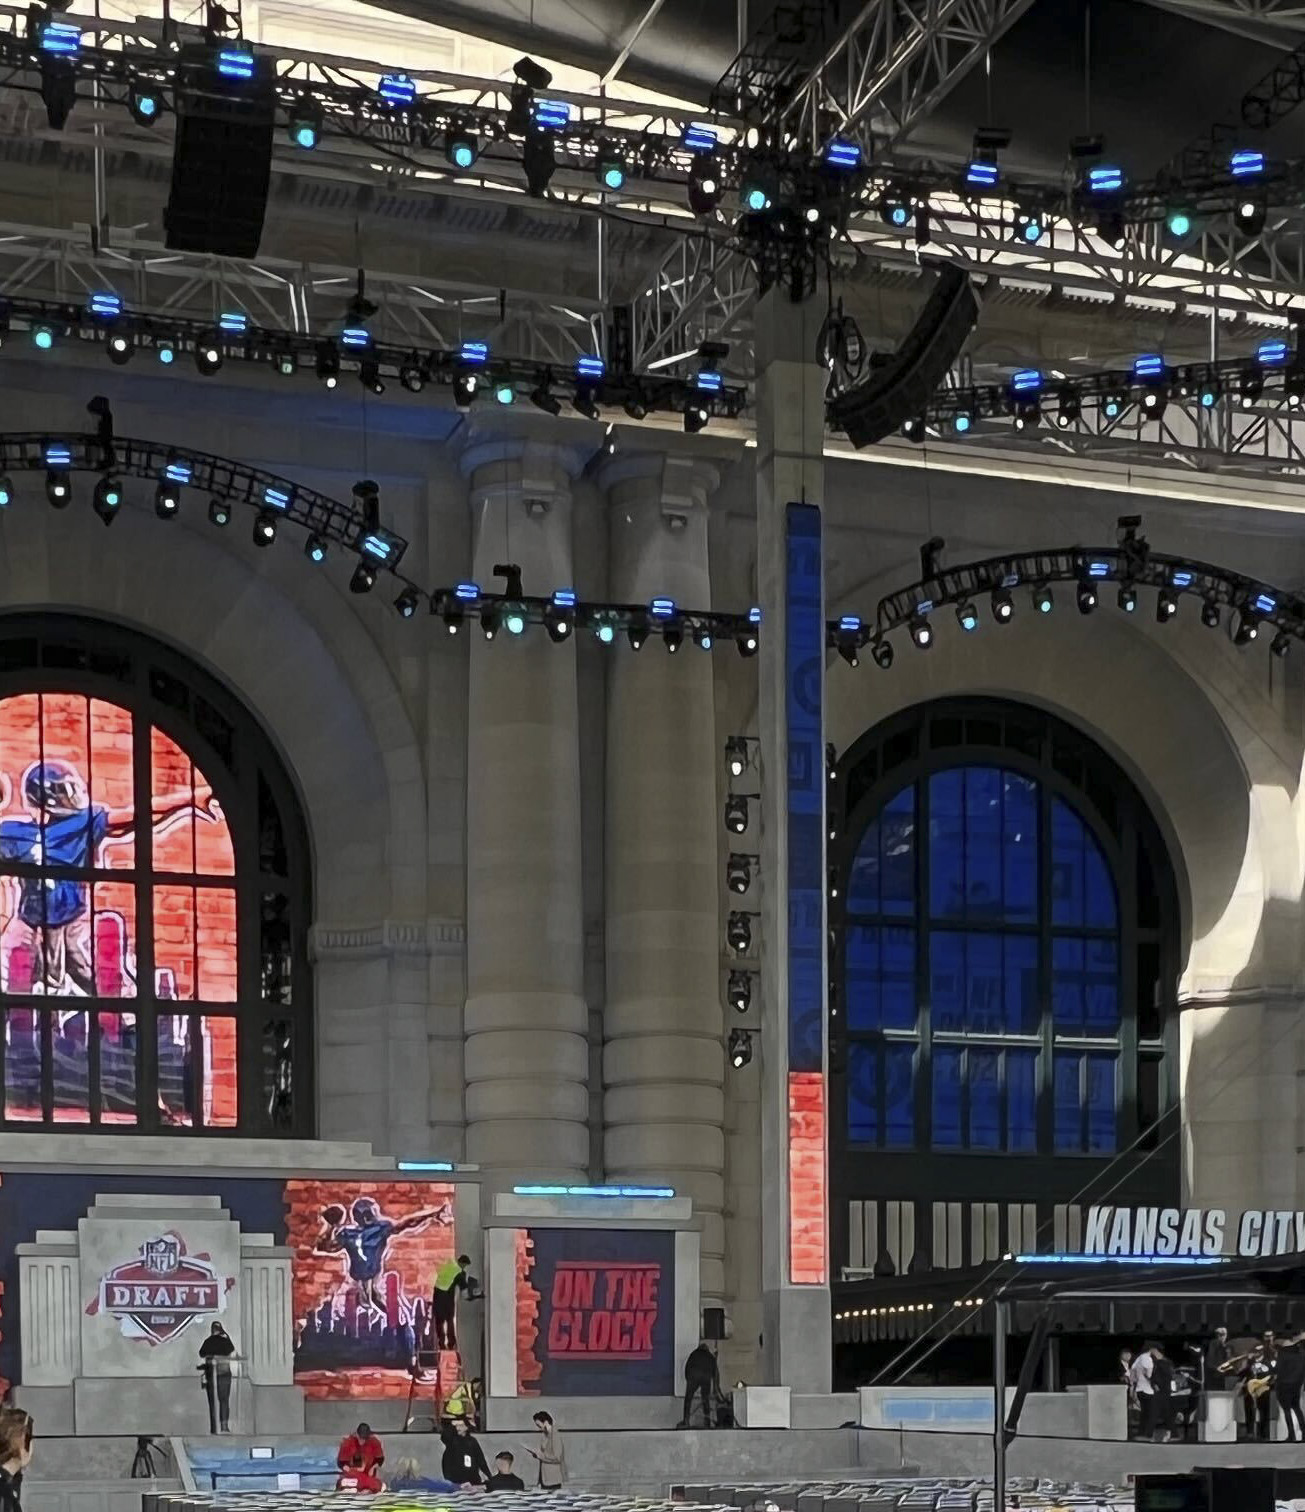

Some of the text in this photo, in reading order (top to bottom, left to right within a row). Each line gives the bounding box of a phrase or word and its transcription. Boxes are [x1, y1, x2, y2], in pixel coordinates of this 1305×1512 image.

[1084, 1206, 1226, 1256] KANSAS
[112, 1286, 212, 1306] DRAFT
[551, 1268, 660, 1311] ON THE
[547, 1310, 655, 1353] CLOCK
